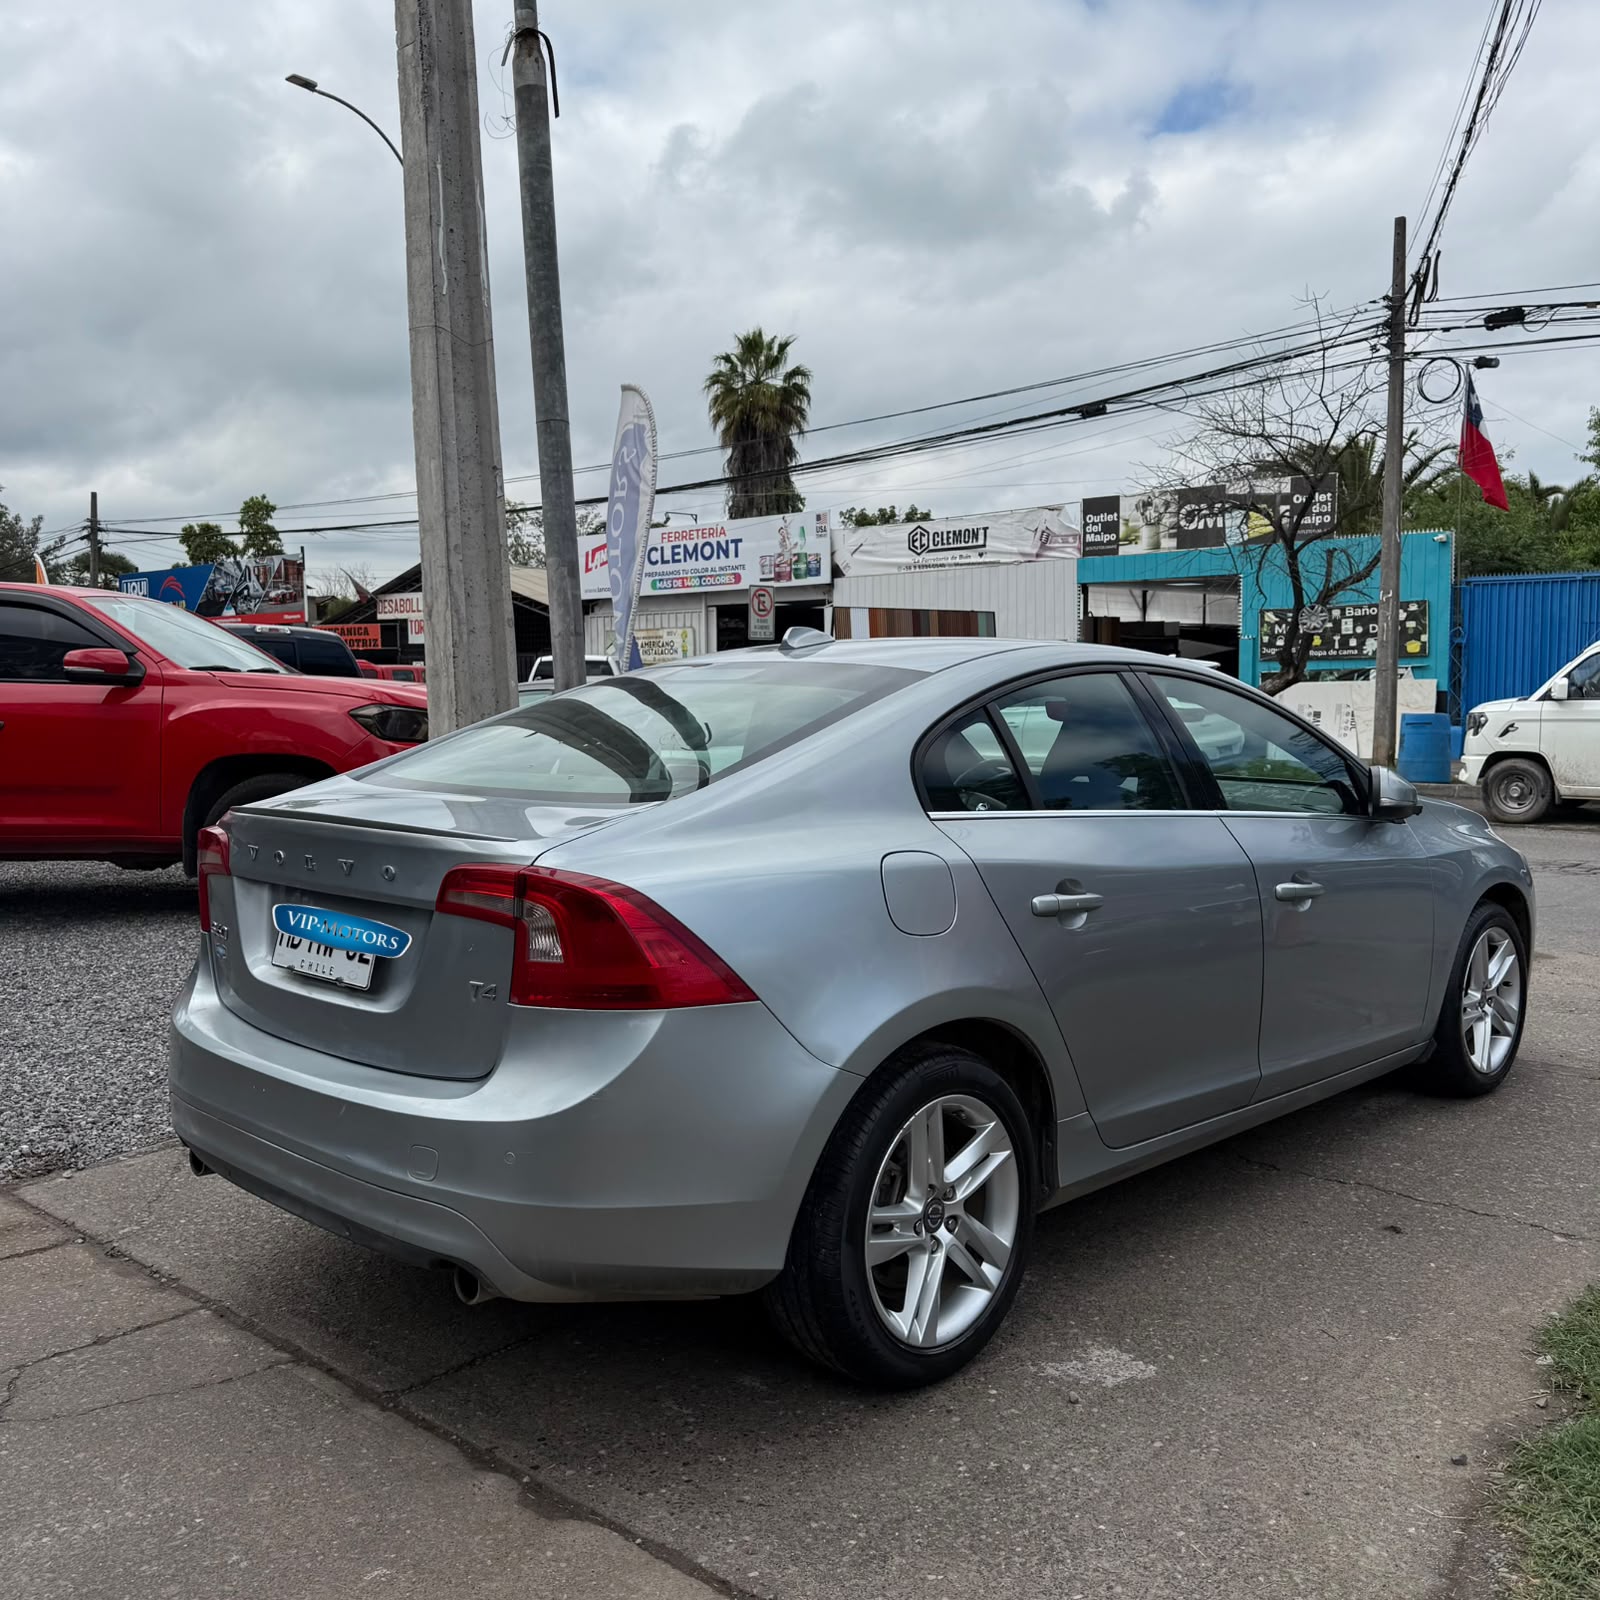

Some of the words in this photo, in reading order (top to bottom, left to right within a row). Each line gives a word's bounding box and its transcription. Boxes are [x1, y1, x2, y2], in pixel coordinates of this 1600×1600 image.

[1293, 492, 1332, 503] Olet
[1086, 512, 1118, 523] Outlet
[661, 524, 726, 543] FERRETERÍA
[815, 525, 828, 534] USA
[1086, 523, 1102, 533] del
[932, 526, 989, 548] CLEMONT
[1086, 532, 1117, 544] Maipo
[585, 544, 608, 573] LAN
[647, 538, 743, 566] CLEMONT
[644, 570, 681, 578] PREPARAMOS
[690, 567, 709, 575] COLOR
[718, 564, 747, 572] INSTANTE
[672, 580, 683, 588] DE
[684, 577, 700, 587] 1400
[701, 574, 735, 585] COLORES
[378, 598, 422, 614] DESABOLL
[1345, 605, 1378, 617] Baño
[409, 619, 424, 636] TOR
[1309, 649, 1327, 658] Ropa
[248, 844, 398, 882] VOLVO
[300, 959, 336, 977] CHILE
[470, 981, 498, 1002] T4
